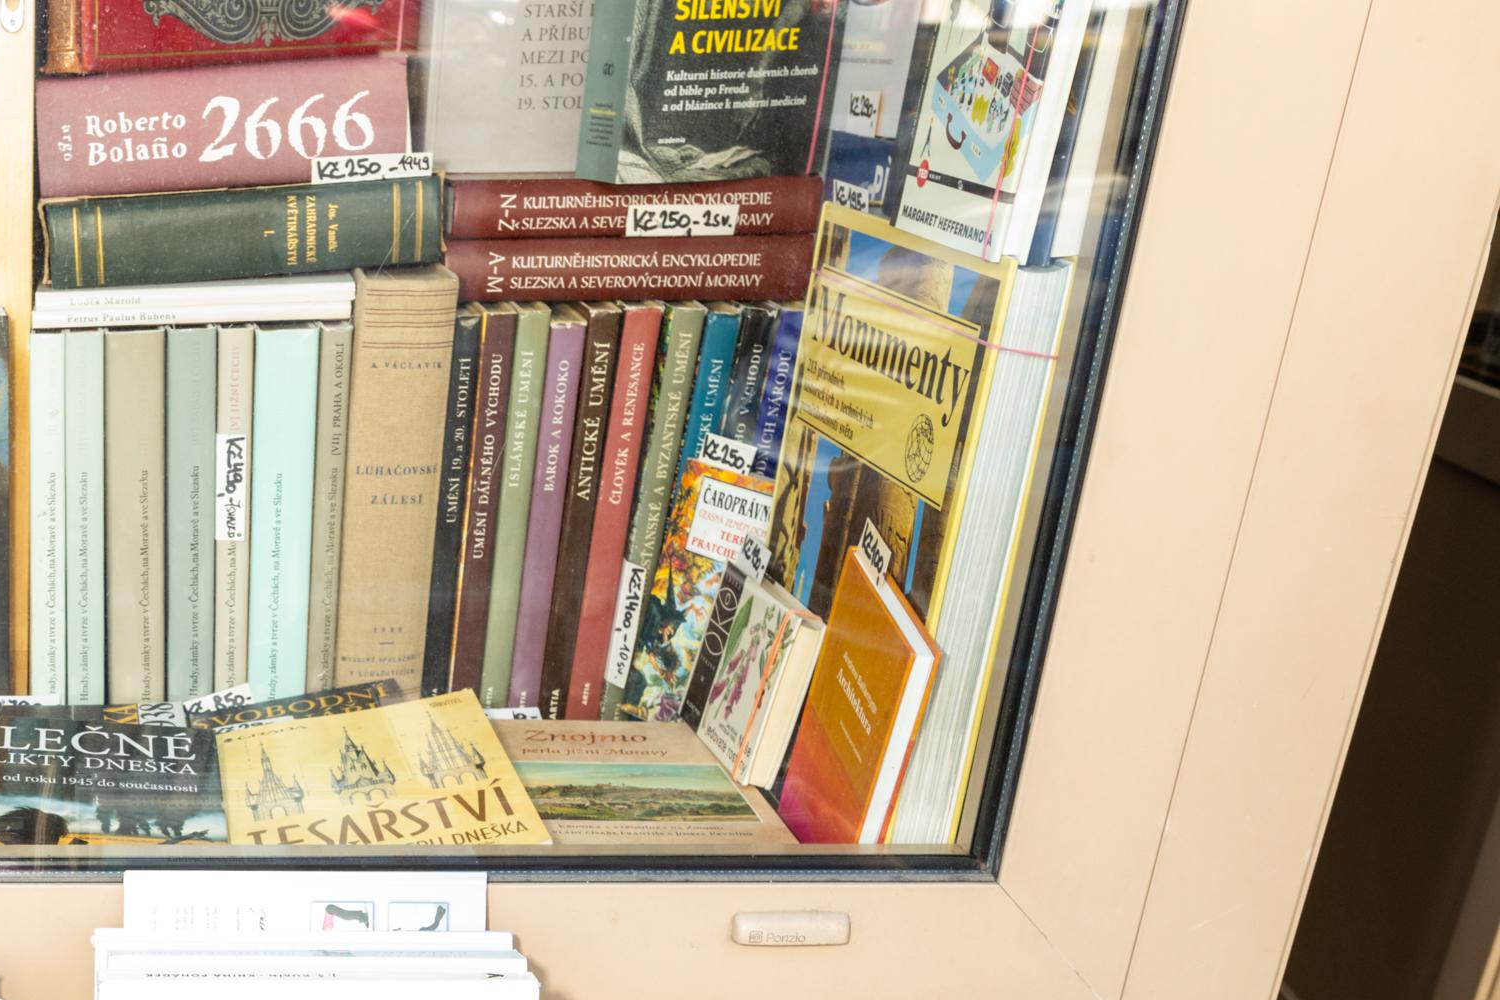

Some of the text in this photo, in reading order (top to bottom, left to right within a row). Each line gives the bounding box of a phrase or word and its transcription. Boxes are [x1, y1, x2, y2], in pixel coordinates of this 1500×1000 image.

[669, 28, 800, 54] A CIVILIZACE
[85, 111, 187, 136] Roberto
[198, 90, 375, 163] 2666
[87, 138, 188, 166] Bolaño
[512, 252, 761, 269] KULTURNĚHISTORICKÁ ENCYKLOPEDIE
[510, 271, 763, 289] SLEZSKA A SEVEROVÝCHODNÍ MORAVY
[811, 286, 971, 428] Monumenty
[543, 446, 560, 492] BAROK
[555, 359, 572, 425] ROKOKO
[576, 341, 611, 501] ANTICKÉ UMĚNÍ
[609, 446, 630, 506] ČLOVĚK
[623, 342, 646, 428] RENESANCE
[472, 352, 504, 560] UMĚNÍ DÁLNÉHO VÝCHODU
[356, 463, 439, 477] LUHAČOVSKÉ
[370, 493, 423, 506] ZÁLESÍ
[525, 730, 649, 748] Znojmo
[84, 754, 198, 775] DNEŠKA
[2, 772, 199, 793] od roku 1945 do současnosti
